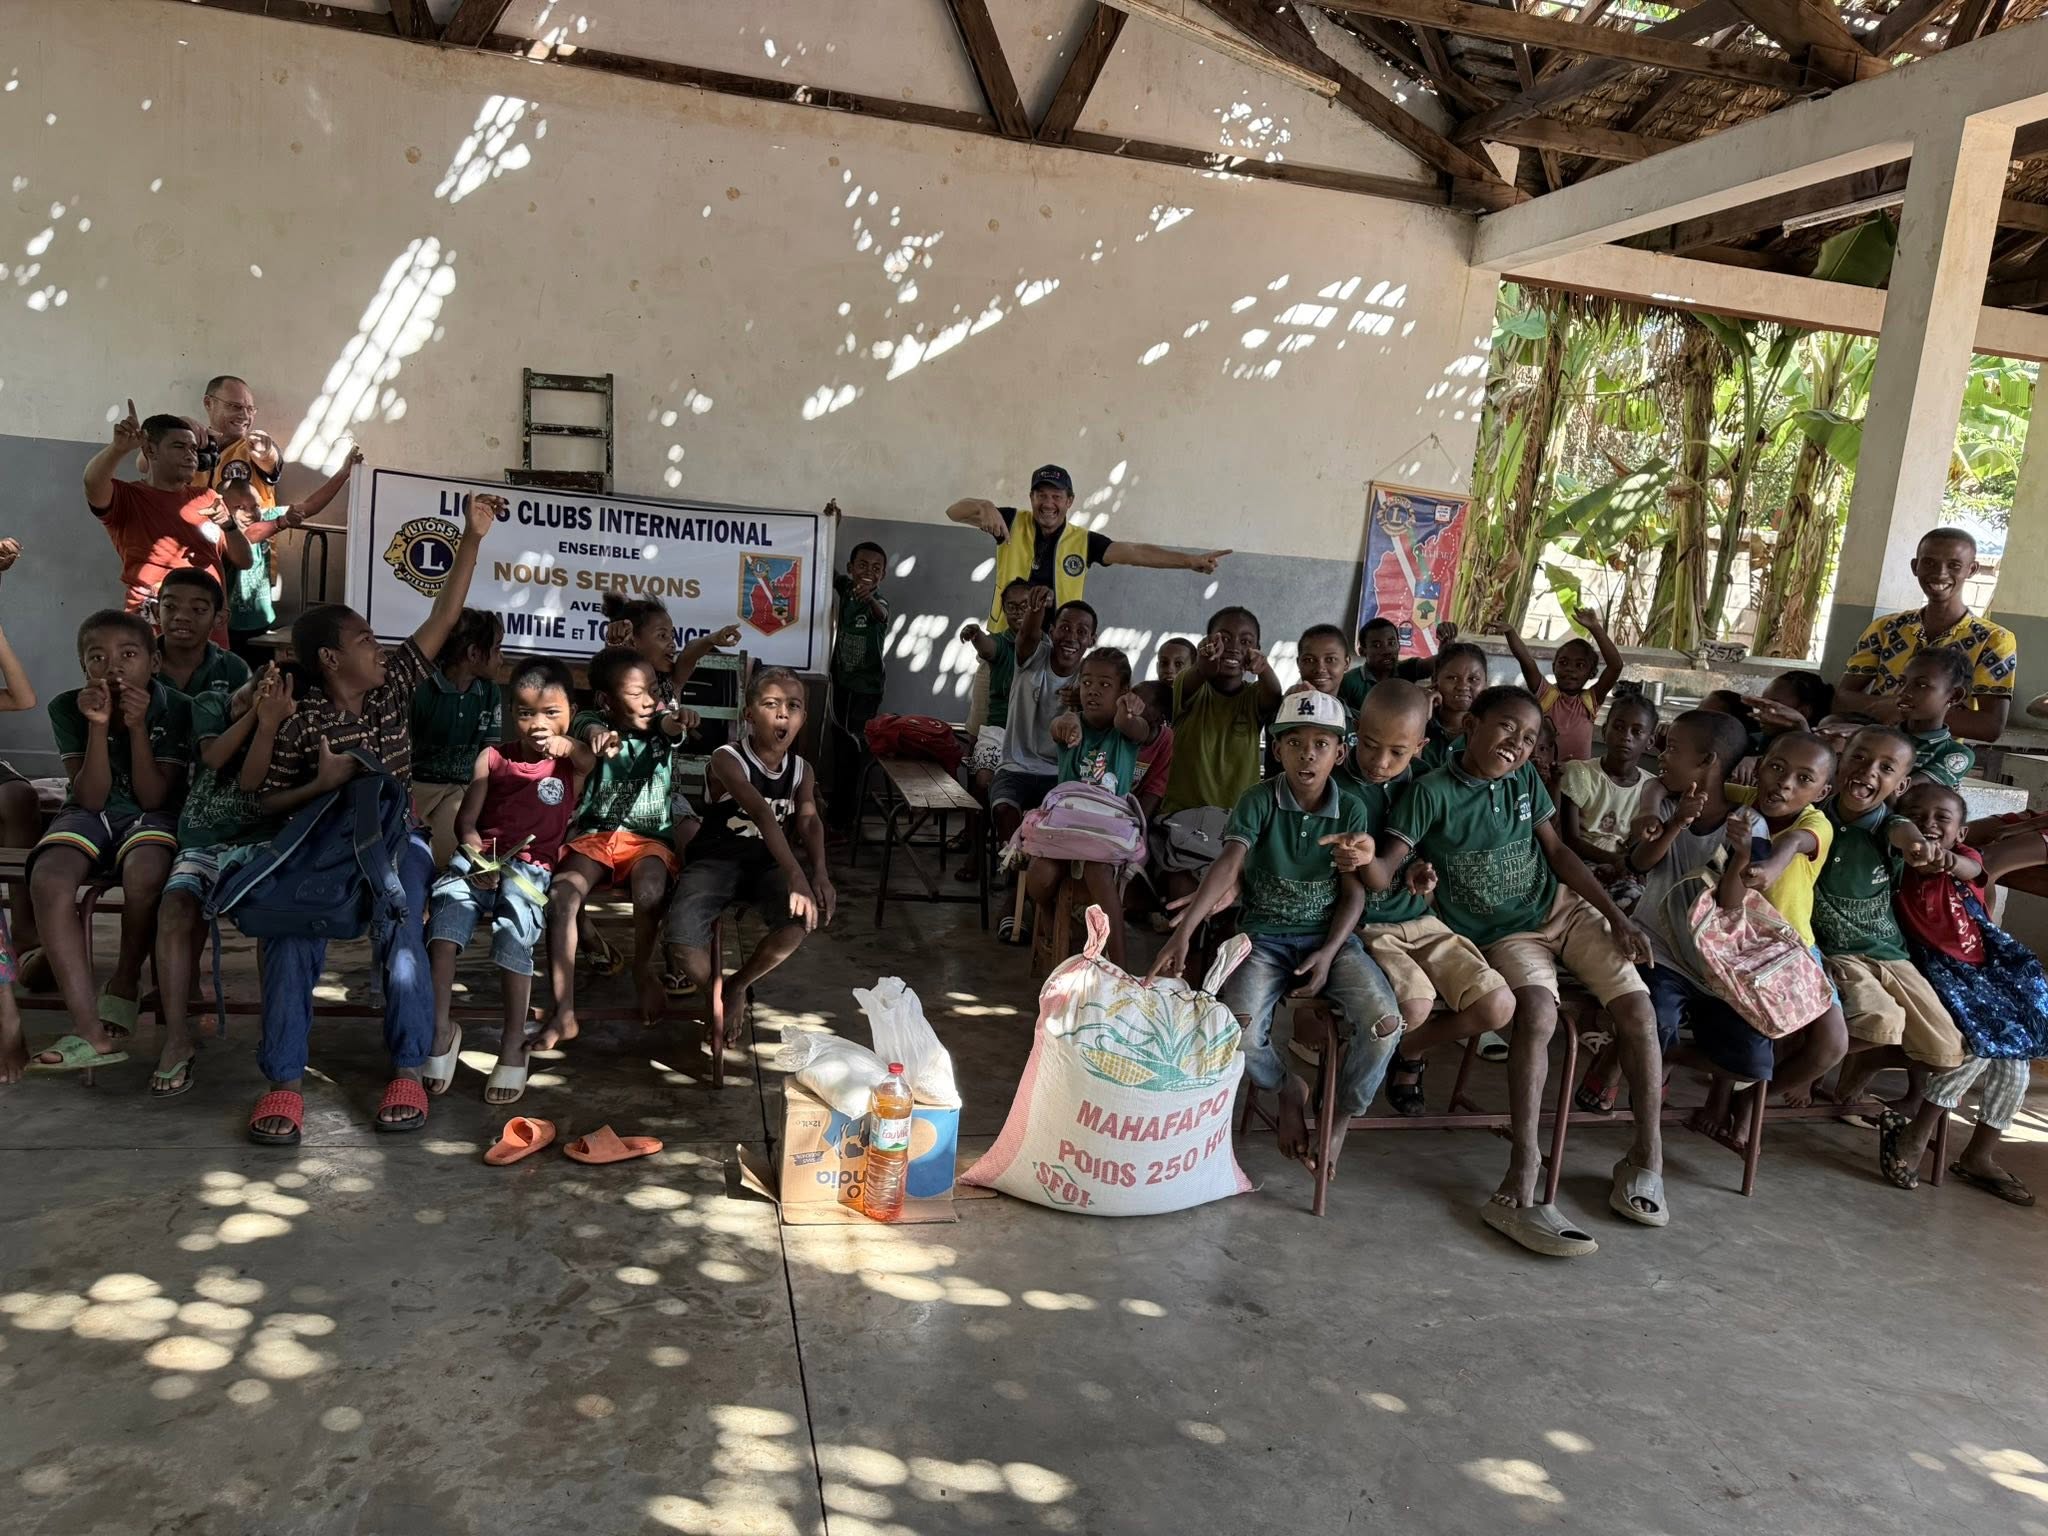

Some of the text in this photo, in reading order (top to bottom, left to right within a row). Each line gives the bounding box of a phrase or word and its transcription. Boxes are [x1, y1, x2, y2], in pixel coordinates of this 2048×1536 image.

[440, 490, 773, 547] LIS CLUBS INTERNATIONAL
[408, 521, 455, 537] LIONS
[419, 541, 445, 571] L
[558, 541, 641, 560] ENSEMBLE
[494, 561, 701, 599] NOUS SERVONS
[570, 600, 603, 613] AVE
[571, 627, 585, 640] ET
[1297, 698, 1315, 715] LA
[1076, 1088, 1229, 1142] MAHAFAPO
[1145, 1147, 1199, 1185] 250
[816, 1170, 867, 1189] ndia
